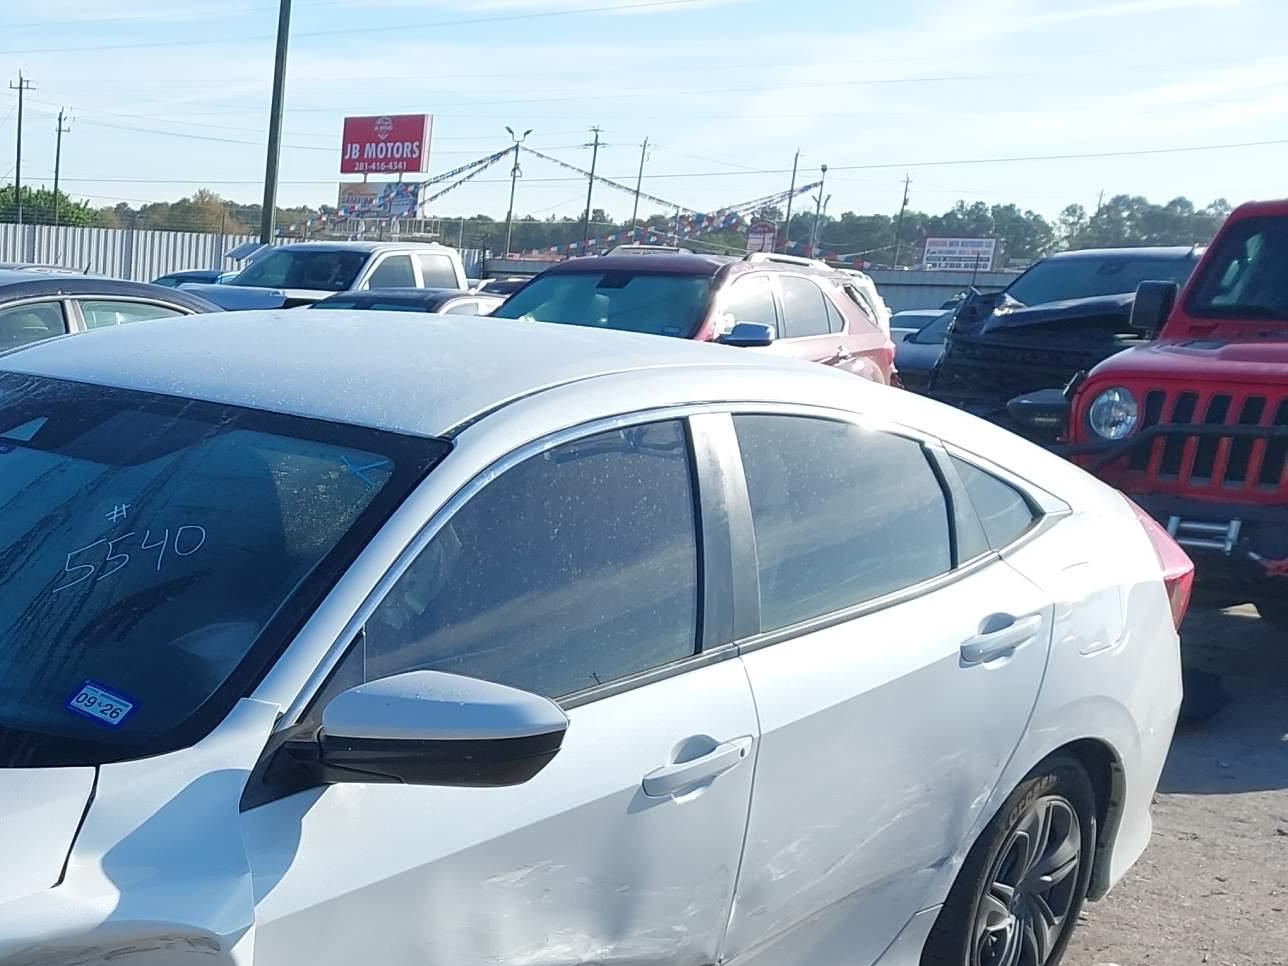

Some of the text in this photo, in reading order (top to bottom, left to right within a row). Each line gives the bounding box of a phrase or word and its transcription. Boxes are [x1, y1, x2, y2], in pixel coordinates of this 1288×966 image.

[344, 141, 420, 160] JB MOTORS
[105, 503, 132, 523] #
[52, 525, 207, 594] 5540
